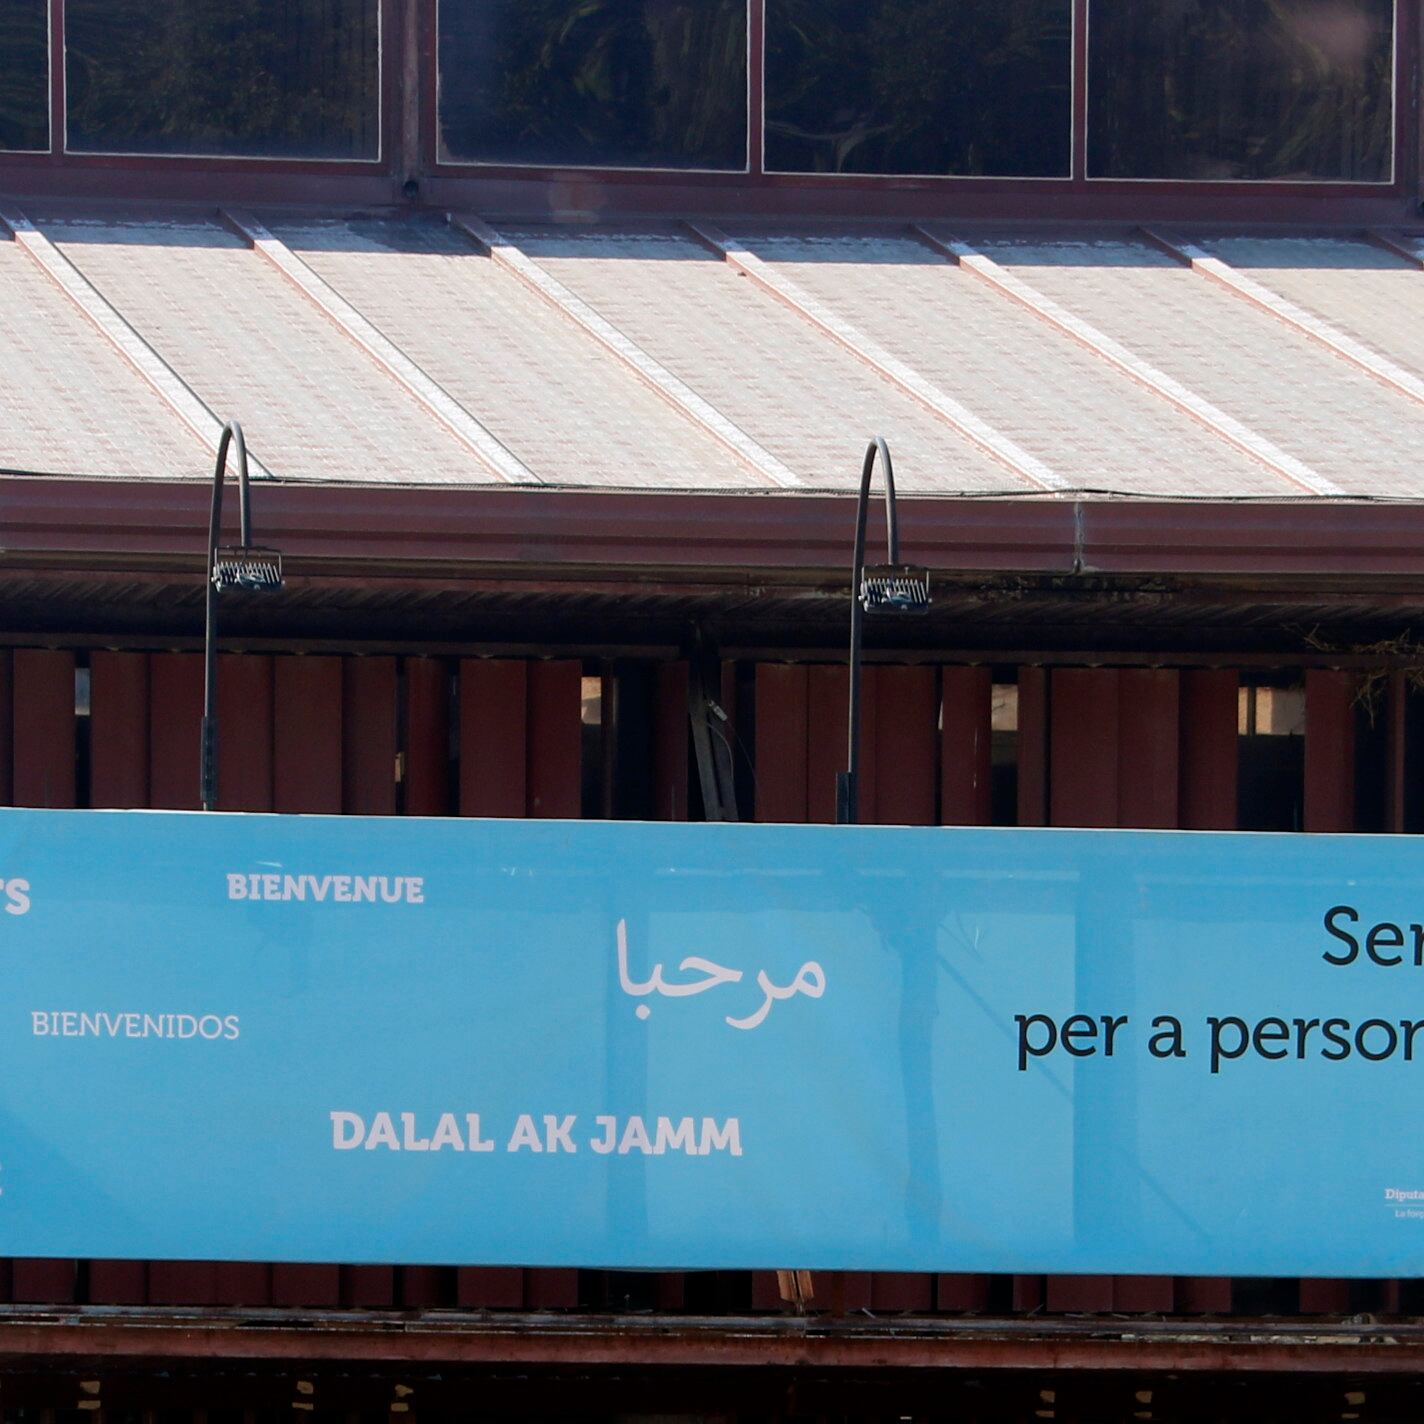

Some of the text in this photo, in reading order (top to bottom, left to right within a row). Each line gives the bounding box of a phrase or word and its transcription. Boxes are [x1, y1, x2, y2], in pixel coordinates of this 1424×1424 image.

[226, 873, 425, 904] BIENVENUE
[616, 918, 827, 1030] مرحبا
[31, 1010, 240, 1040] BIENVENIDOS
[1014, 1013, 1129, 1072] per
[1148, 1015, 1187, 1058] a
[329, 1110, 744, 1157] DALAL AK JAMM
